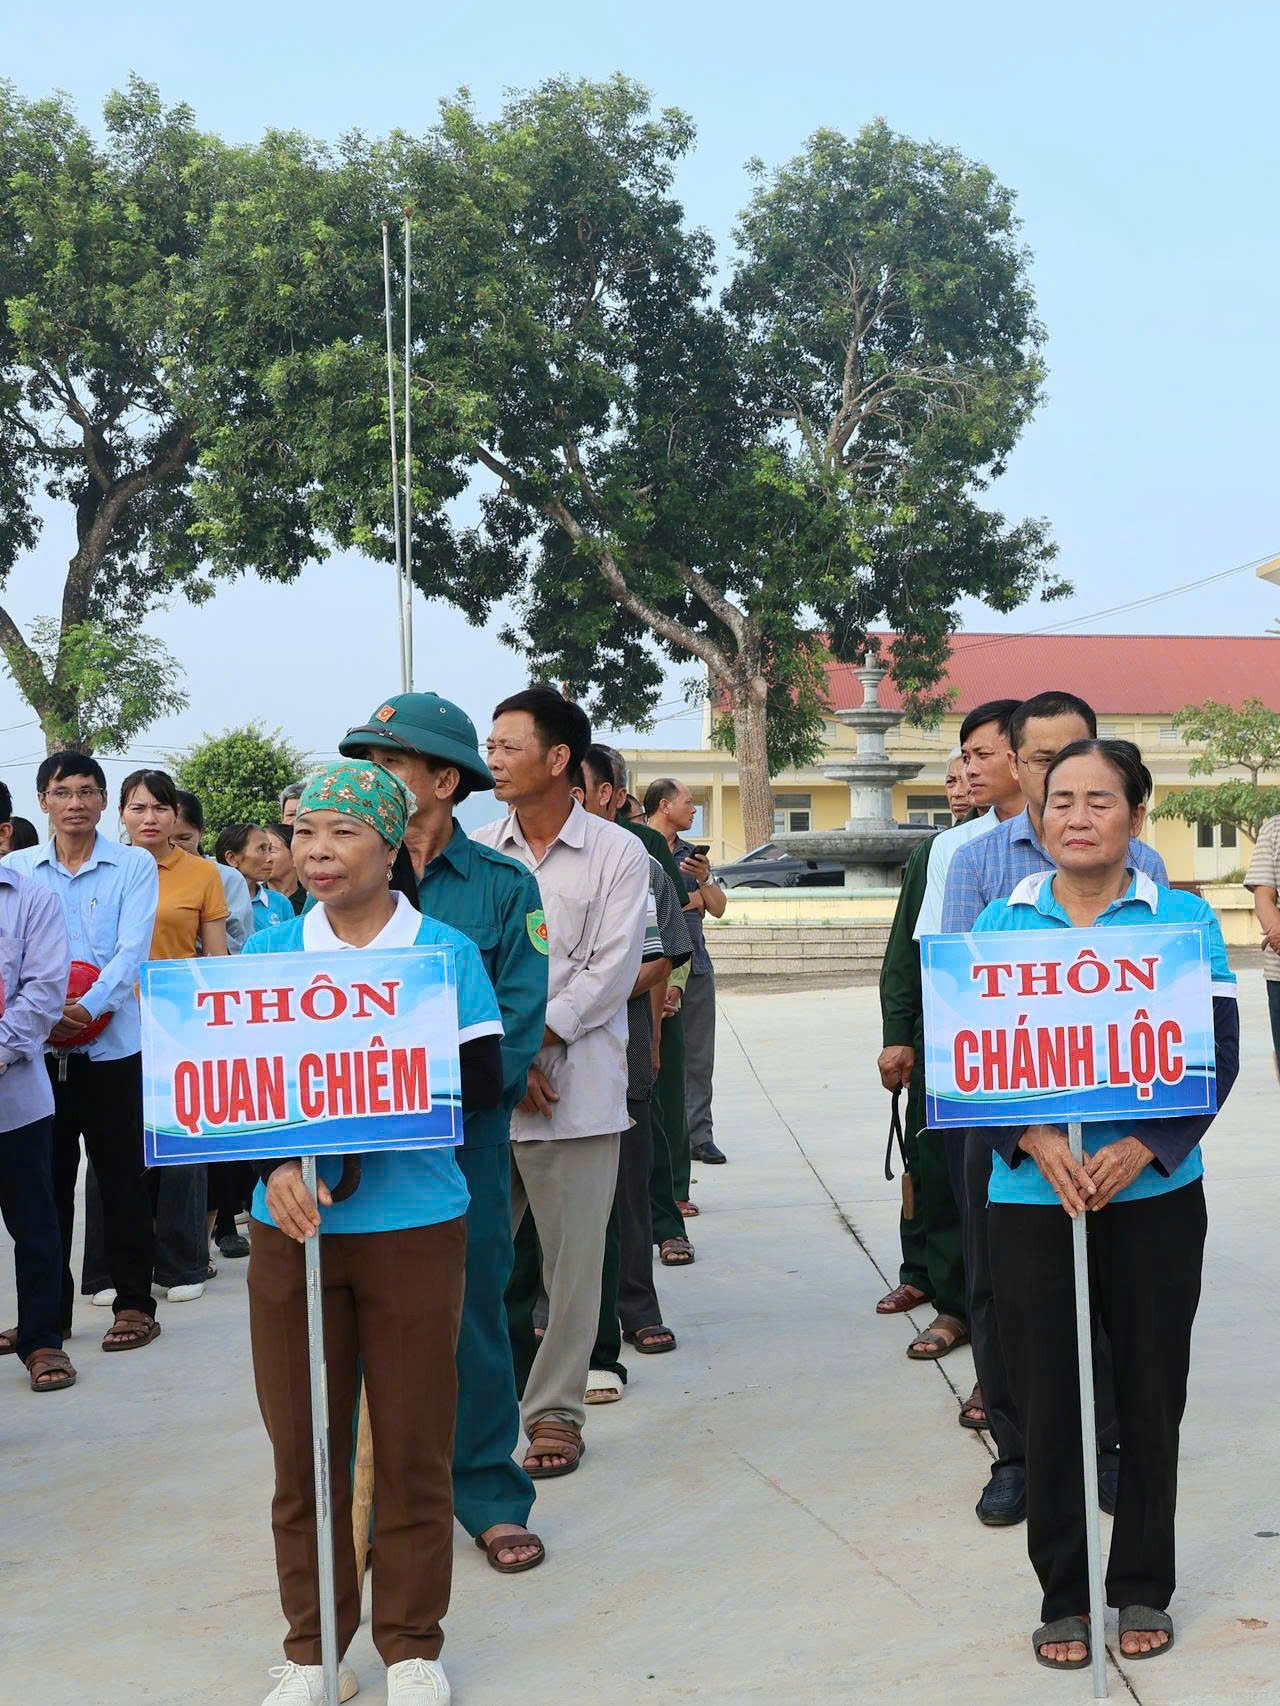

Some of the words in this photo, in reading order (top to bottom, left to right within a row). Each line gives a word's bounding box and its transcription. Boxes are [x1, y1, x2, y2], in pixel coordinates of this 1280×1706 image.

[196, 974, 400, 1026] THÔN
[972, 949, 1159, 998] THÔN
[174, 1055, 286, 1134] QUAN
[298, 1035, 429, 1118] CHIÊM
[953, 1014, 1095, 1093] CHÁNH
[1107, 1008, 1184, 1097] LỘC
